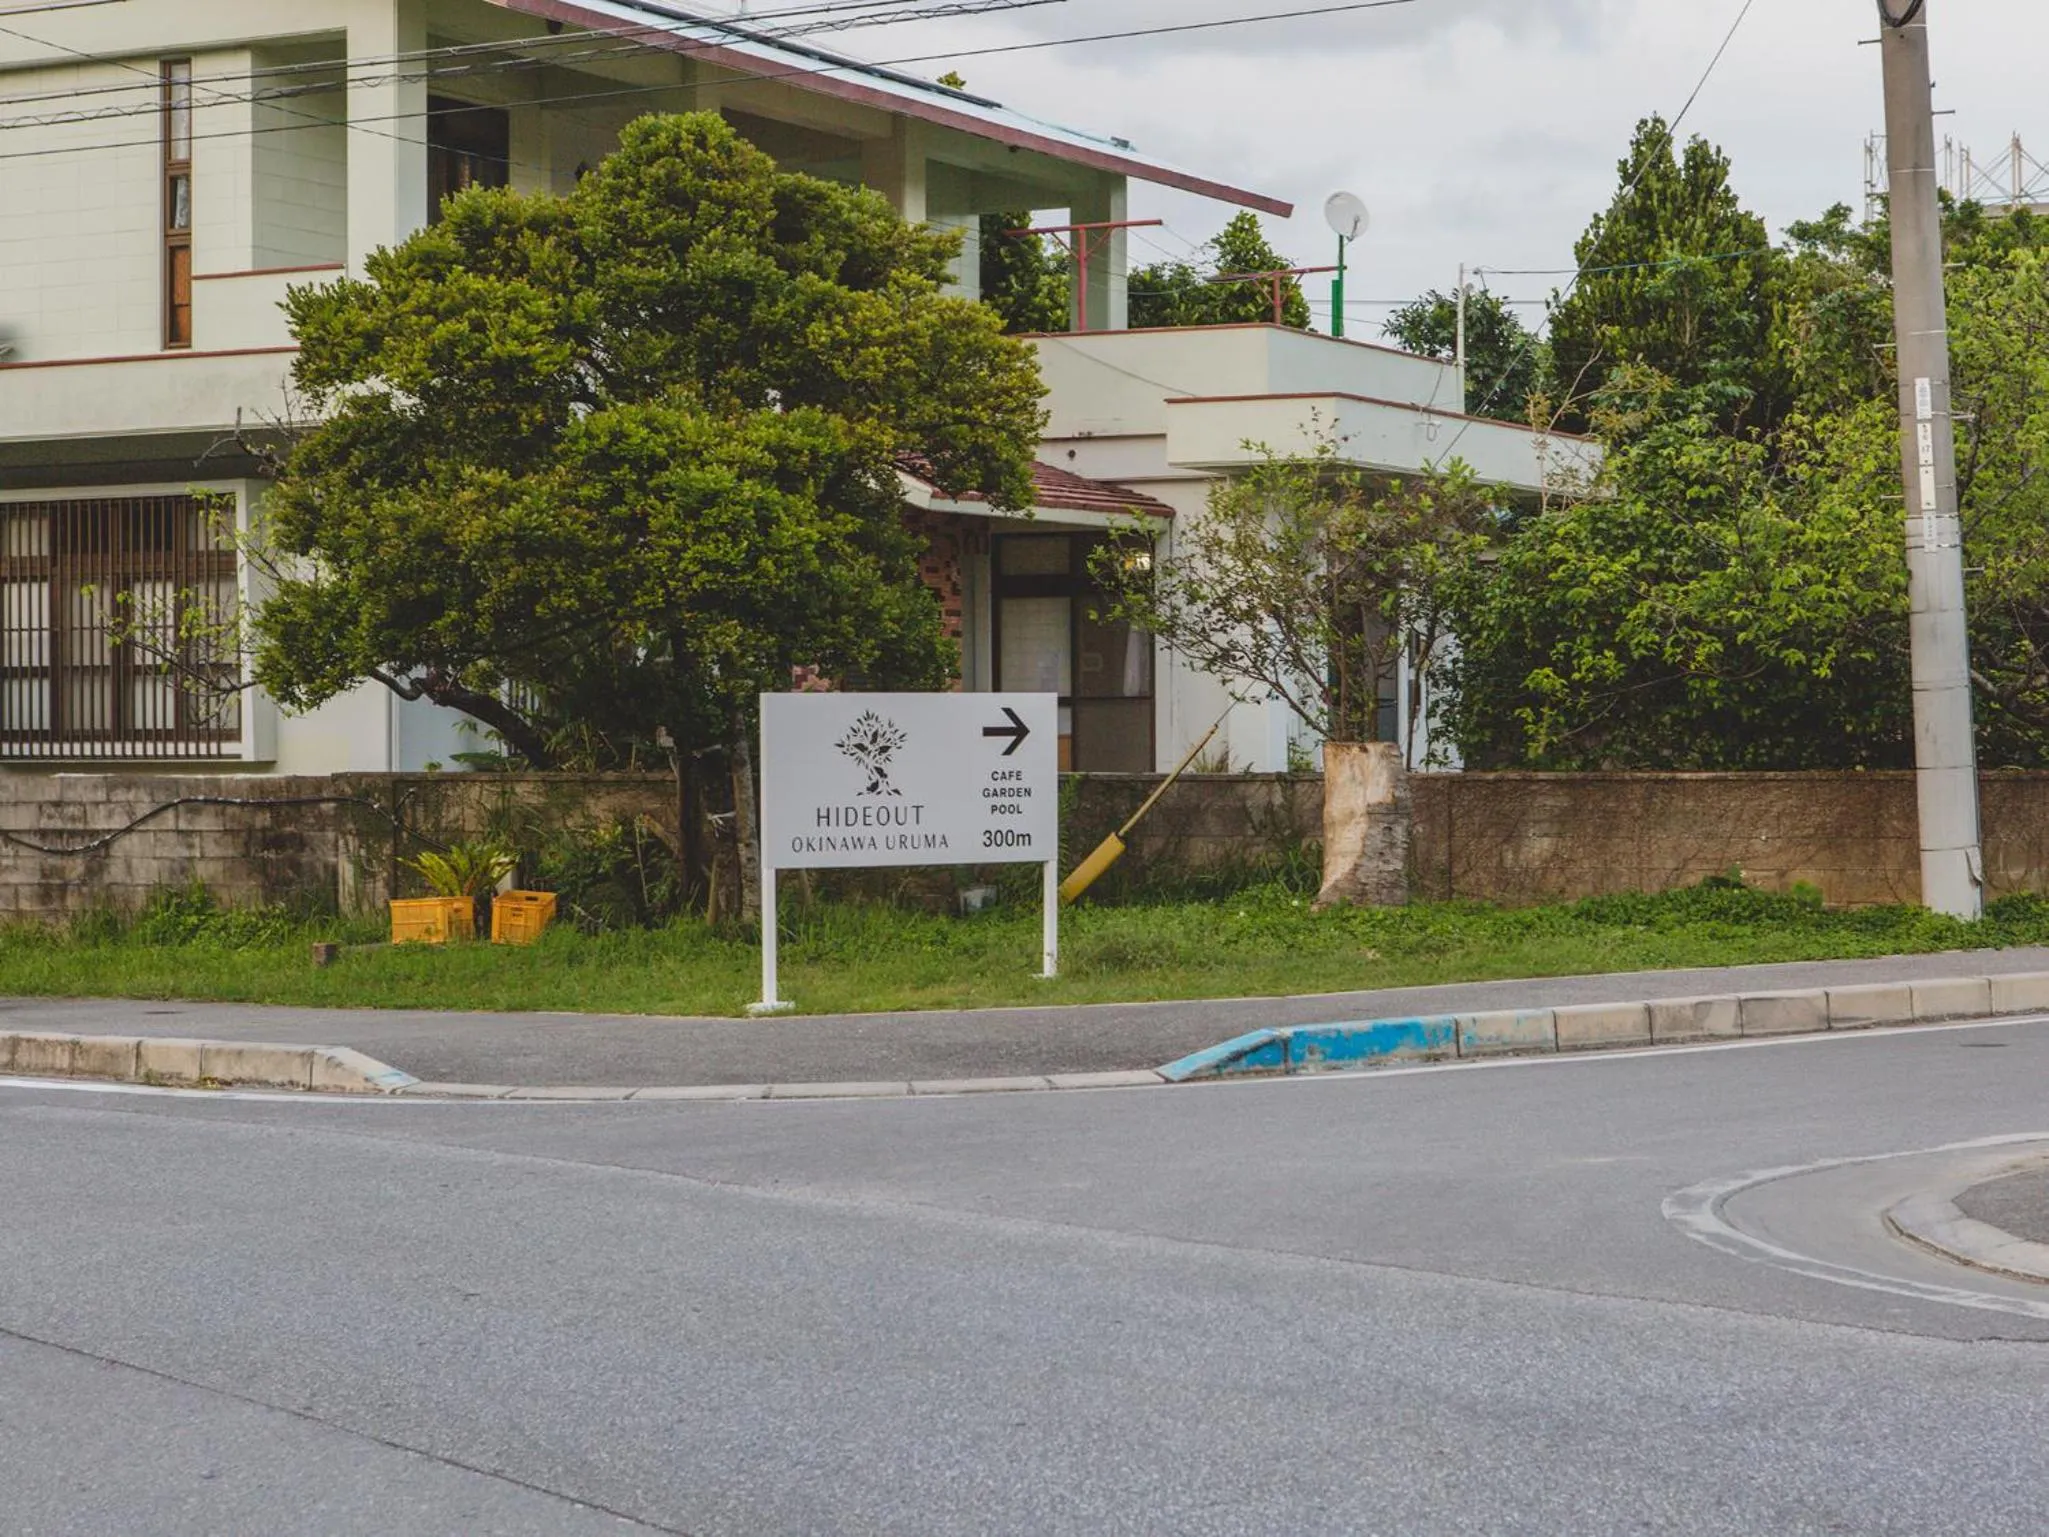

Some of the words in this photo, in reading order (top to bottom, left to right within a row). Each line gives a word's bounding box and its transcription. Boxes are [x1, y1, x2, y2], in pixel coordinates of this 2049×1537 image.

[991, 771, 1022, 781] CAFE
[982, 787, 1032, 798] GARDEN
[816, 805, 924, 827] HIDEOUT
[991, 804, 1022, 815] POOL
[791, 835, 878, 853] OKINAWA
[886, 833, 950, 850] URUMA
[982, 830, 1032, 848] 300m
